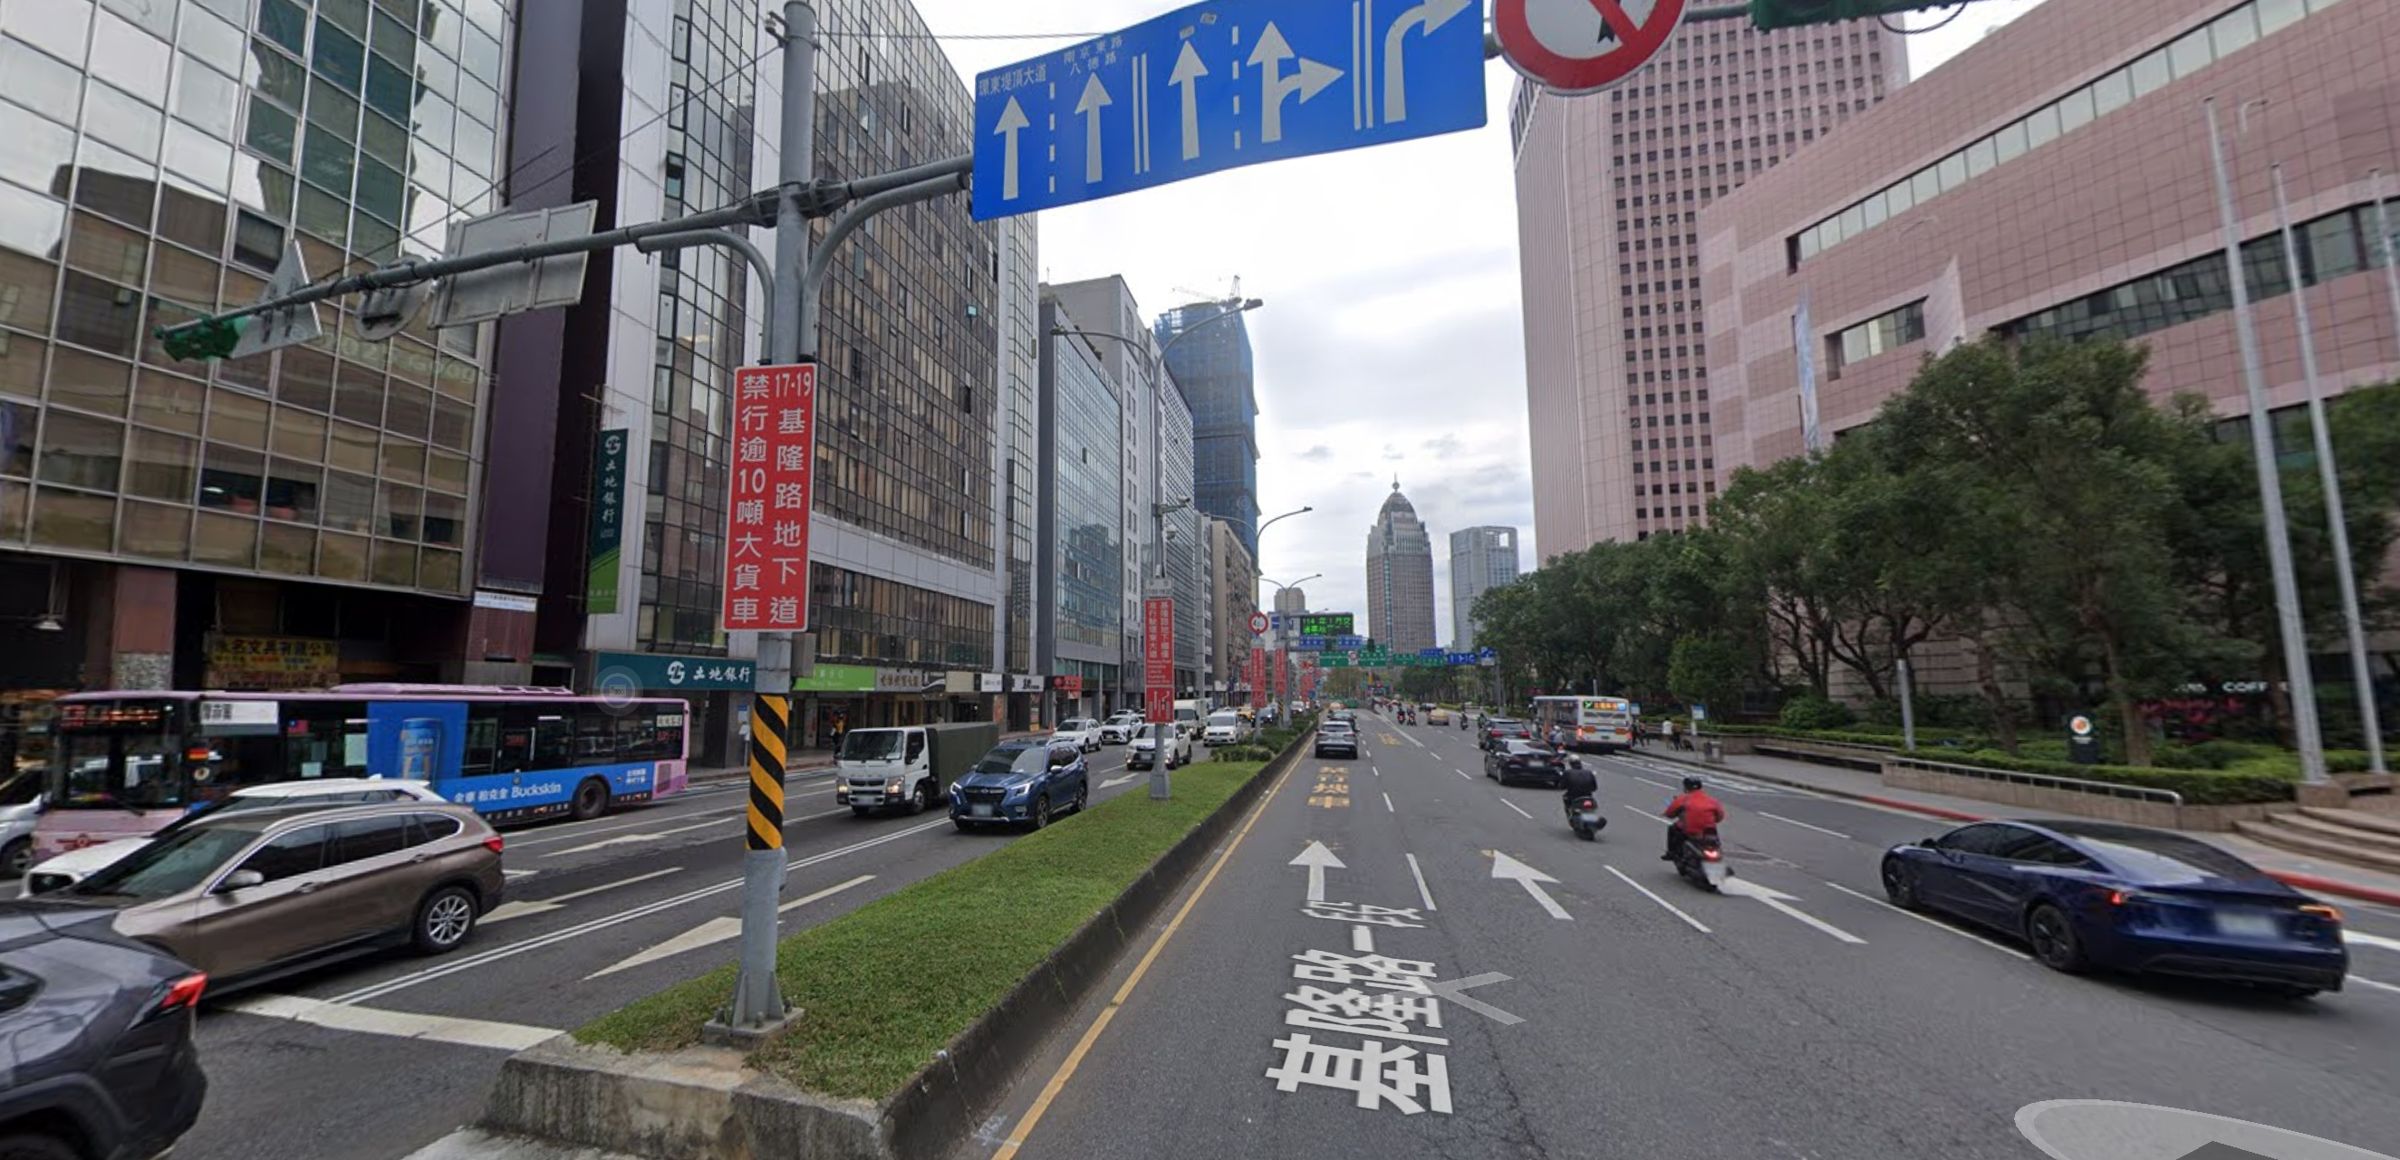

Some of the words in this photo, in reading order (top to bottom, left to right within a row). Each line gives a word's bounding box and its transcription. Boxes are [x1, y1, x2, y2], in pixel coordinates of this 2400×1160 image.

[1063, 35, 1124, 64] 南京東路
[1070, 52, 1117, 76] 八德路
[978, 64, 1047, 96] 環東堤頂大道
[775, 372, 812, 397] 17-19
[602, 459, 618, 524] 土地銀行
[731, 374, 769, 624] 禁行逾10噸大貨車
[769, 408, 806, 624] 基隆路地下道
[693, 666, 751, 683] 土地銀行
[511, 783, 562, 799] Buckskin
[1265, 900, 1453, 1115] 基隆路一段
